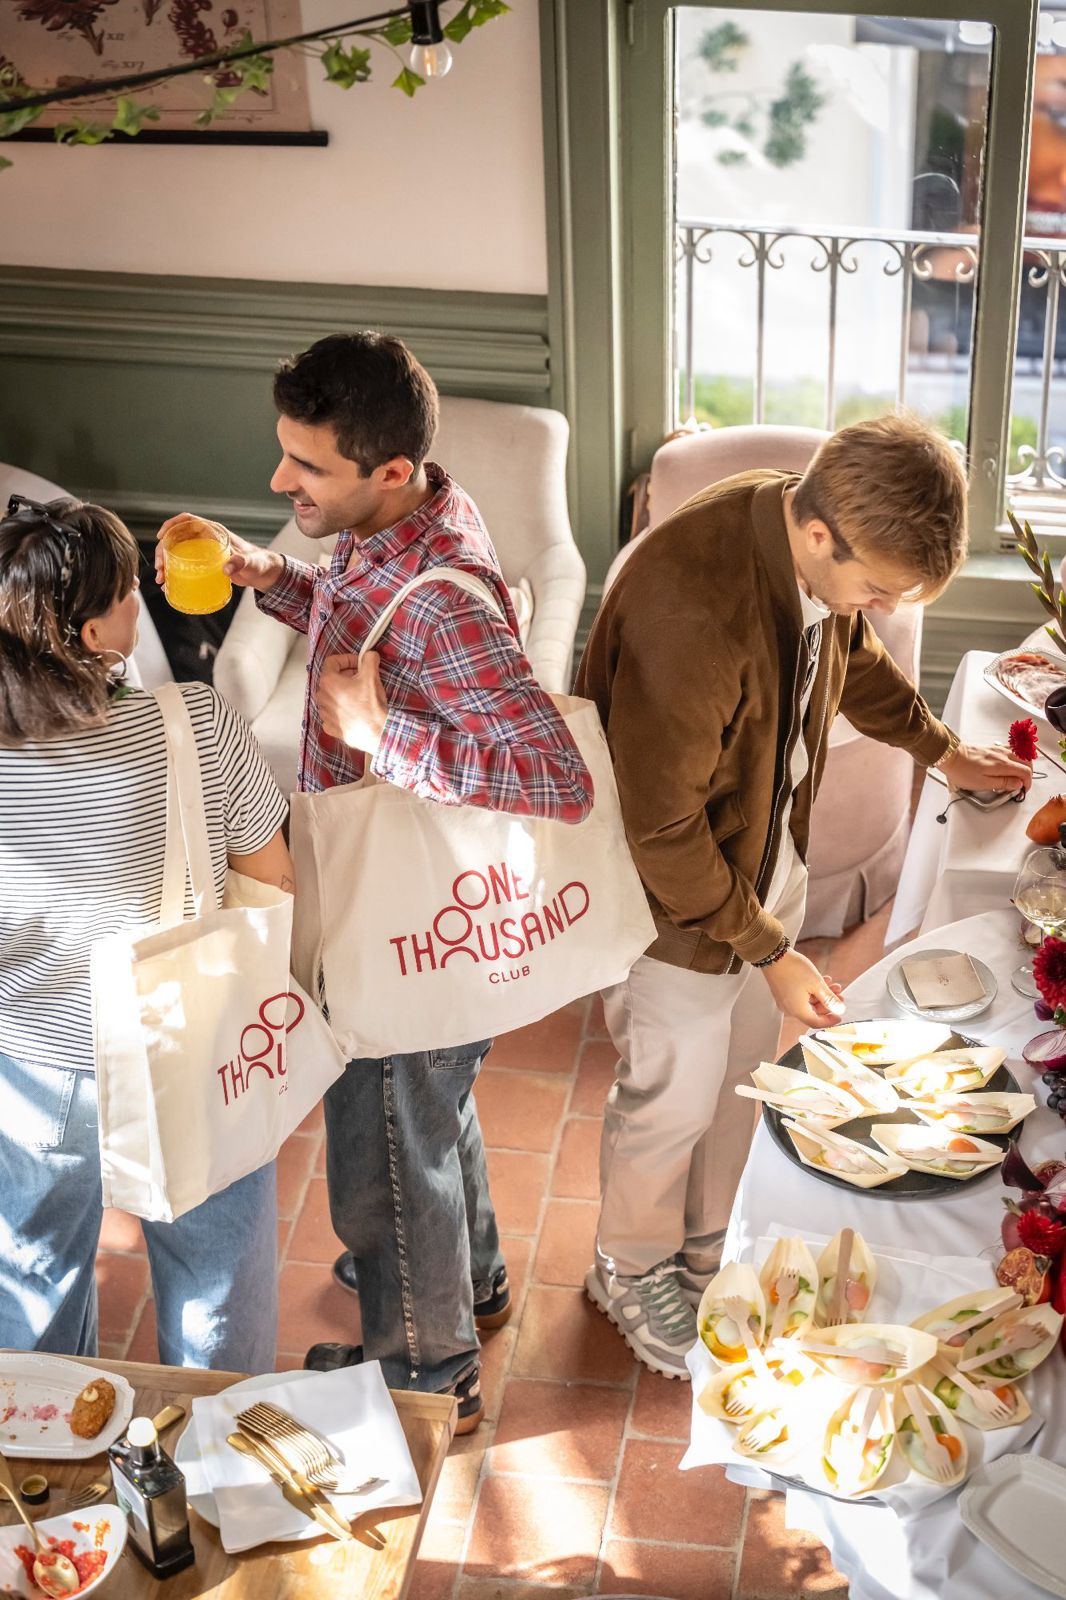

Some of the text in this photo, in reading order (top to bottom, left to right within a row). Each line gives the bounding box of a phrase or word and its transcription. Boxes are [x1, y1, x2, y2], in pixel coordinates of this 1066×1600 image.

[452, 862, 529, 910] ONE
[389, 881, 590, 975] THOUSAND
[488, 965, 531, 984] CLUB
